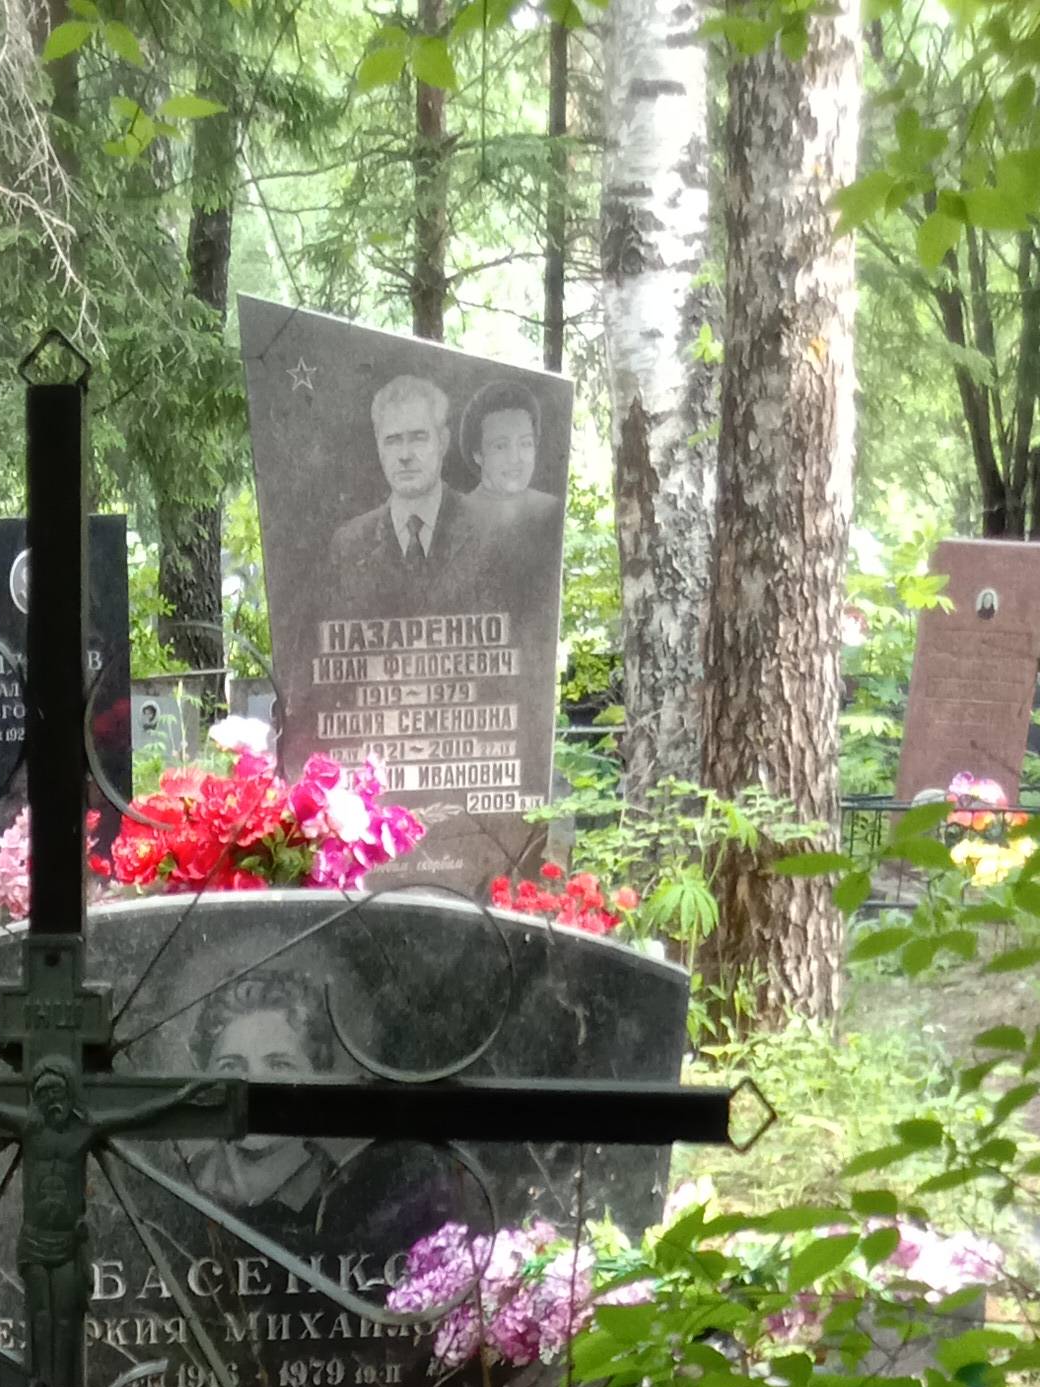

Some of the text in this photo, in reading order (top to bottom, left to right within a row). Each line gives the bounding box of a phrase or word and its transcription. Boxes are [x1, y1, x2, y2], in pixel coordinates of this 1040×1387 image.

[329, 614, 503, 651] НАЗАРЕНКО
[318, 651, 514, 682] ИВАН ФЕДОСЕЕВИЧ
[321, 706, 514, 736] ЛИДИЯ СЕМЕНОВНА
[418, 763, 517, 789] ИВАНОВИЧ
[469, 792, 516, 812] 2009
[279, 1356, 346, 1387] 1979
